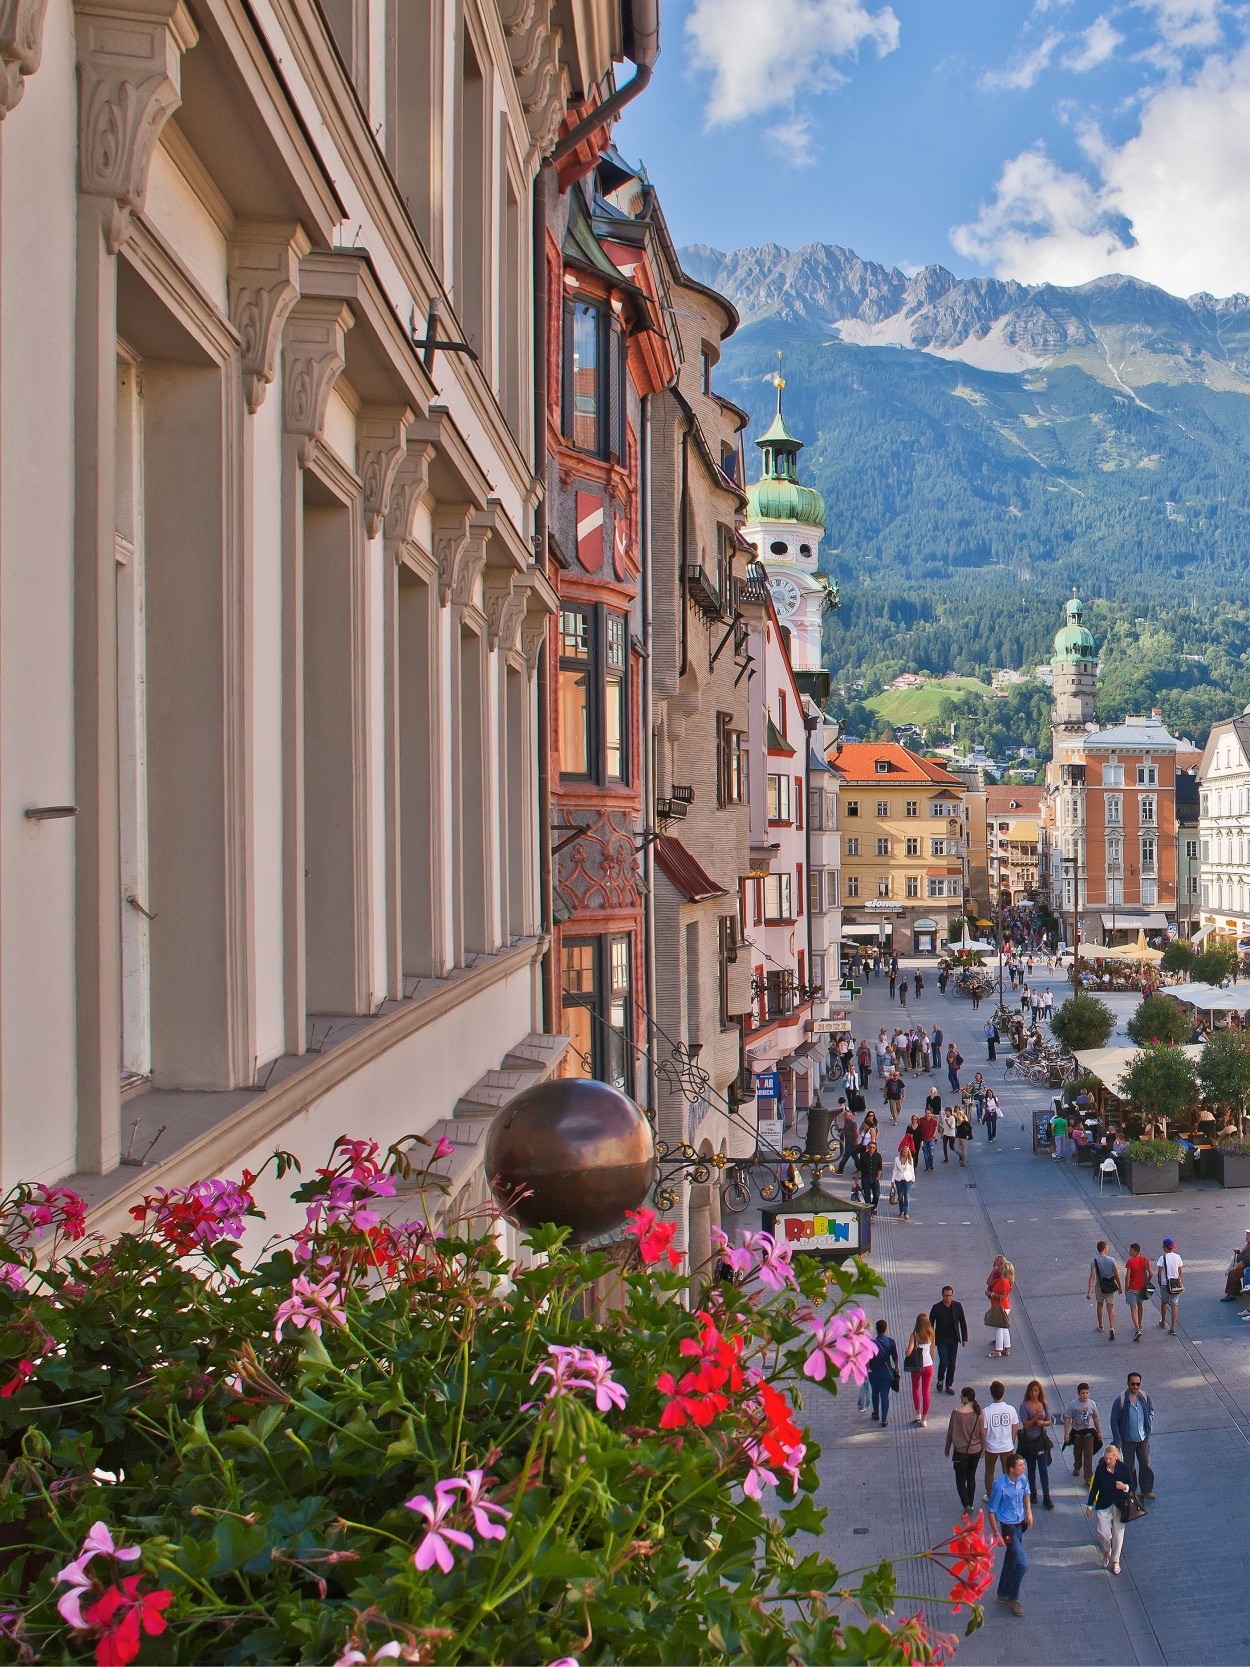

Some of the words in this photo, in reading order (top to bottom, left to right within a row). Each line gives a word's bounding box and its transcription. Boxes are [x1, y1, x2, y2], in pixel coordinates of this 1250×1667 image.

[784, 1216, 849, 1242] ROBIN
[800, 1236, 837, 1246] BOOK
[992, 1413, 1010, 1427] 08
